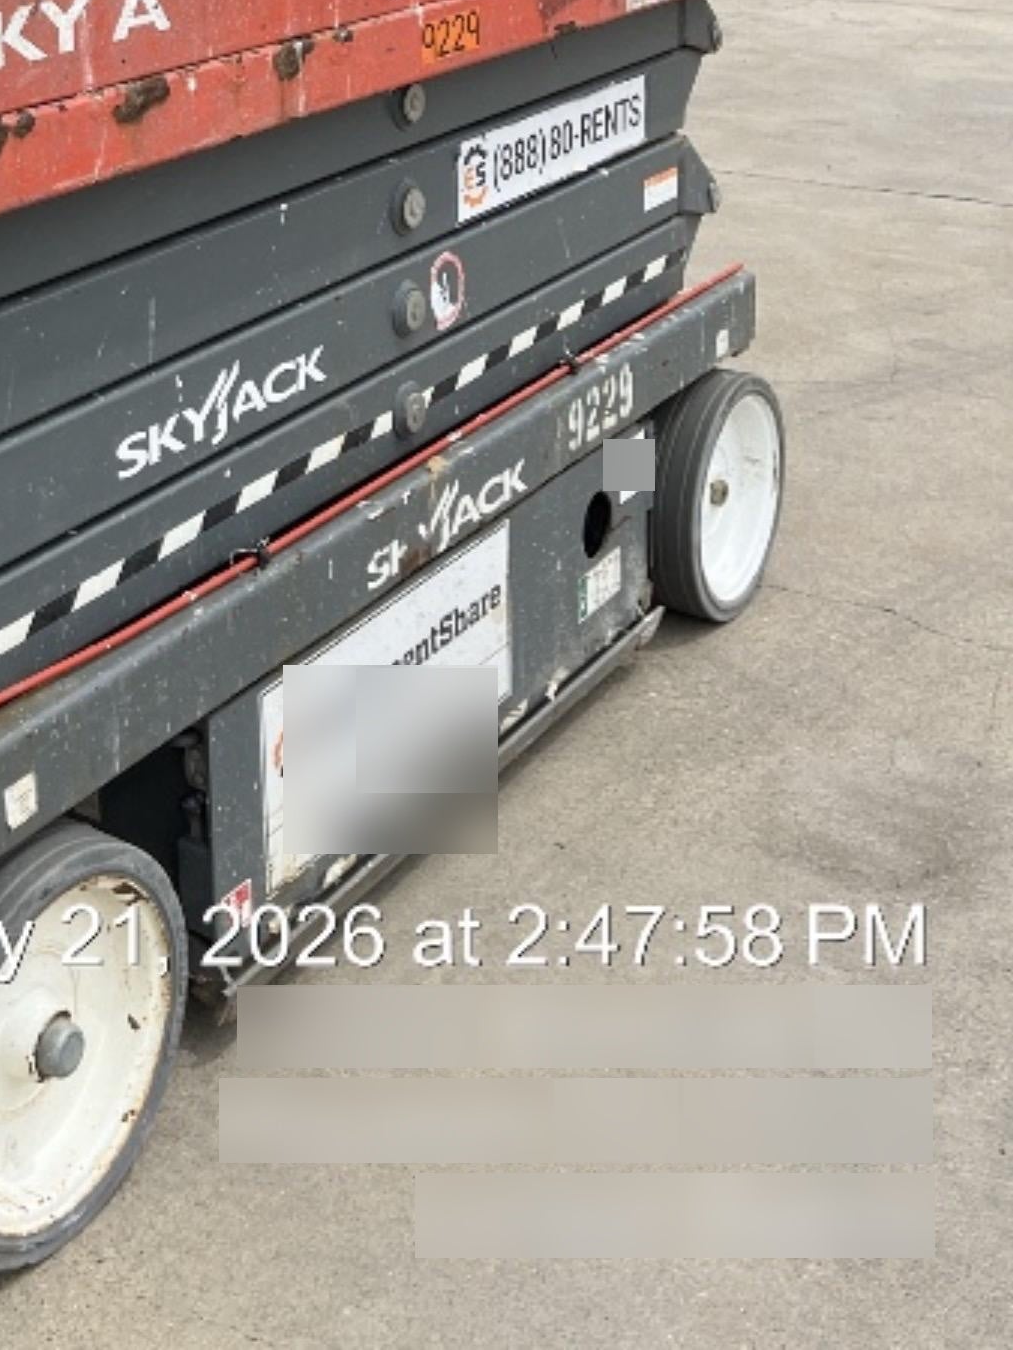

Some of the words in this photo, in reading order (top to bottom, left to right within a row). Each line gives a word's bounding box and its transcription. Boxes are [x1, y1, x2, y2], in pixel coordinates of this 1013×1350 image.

[422, 11, 481, 58] 9229
[493, 126, 548, 192] (888)
[550, 94, 642, 161] 80-RENTS
[115, 344, 328, 479] SKYJACK
[568, 362, 635, 451] 9229
